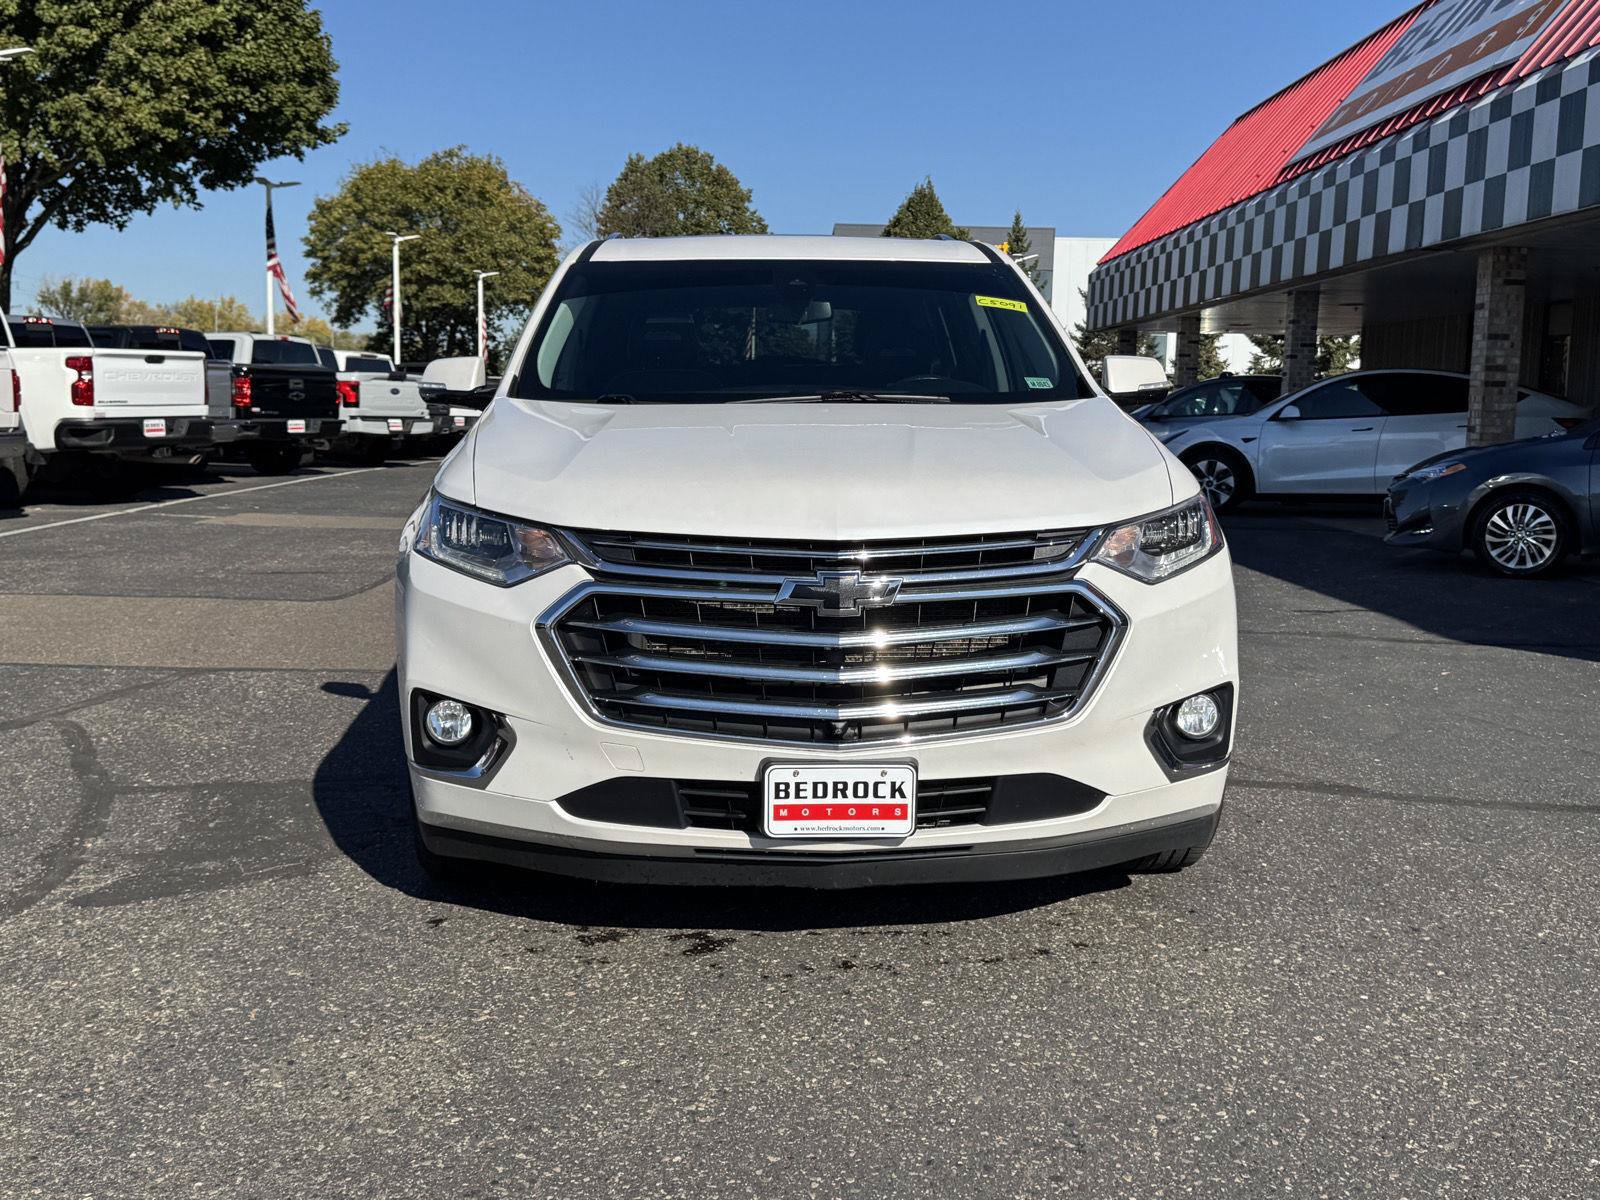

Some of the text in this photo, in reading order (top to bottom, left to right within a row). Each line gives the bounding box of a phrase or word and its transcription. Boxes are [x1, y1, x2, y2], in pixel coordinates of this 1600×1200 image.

[104, 370, 199, 382] CHEVROLET
[774, 781, 907, 799] BEDROCK
[779, 808, 902, 816] MOTORS
